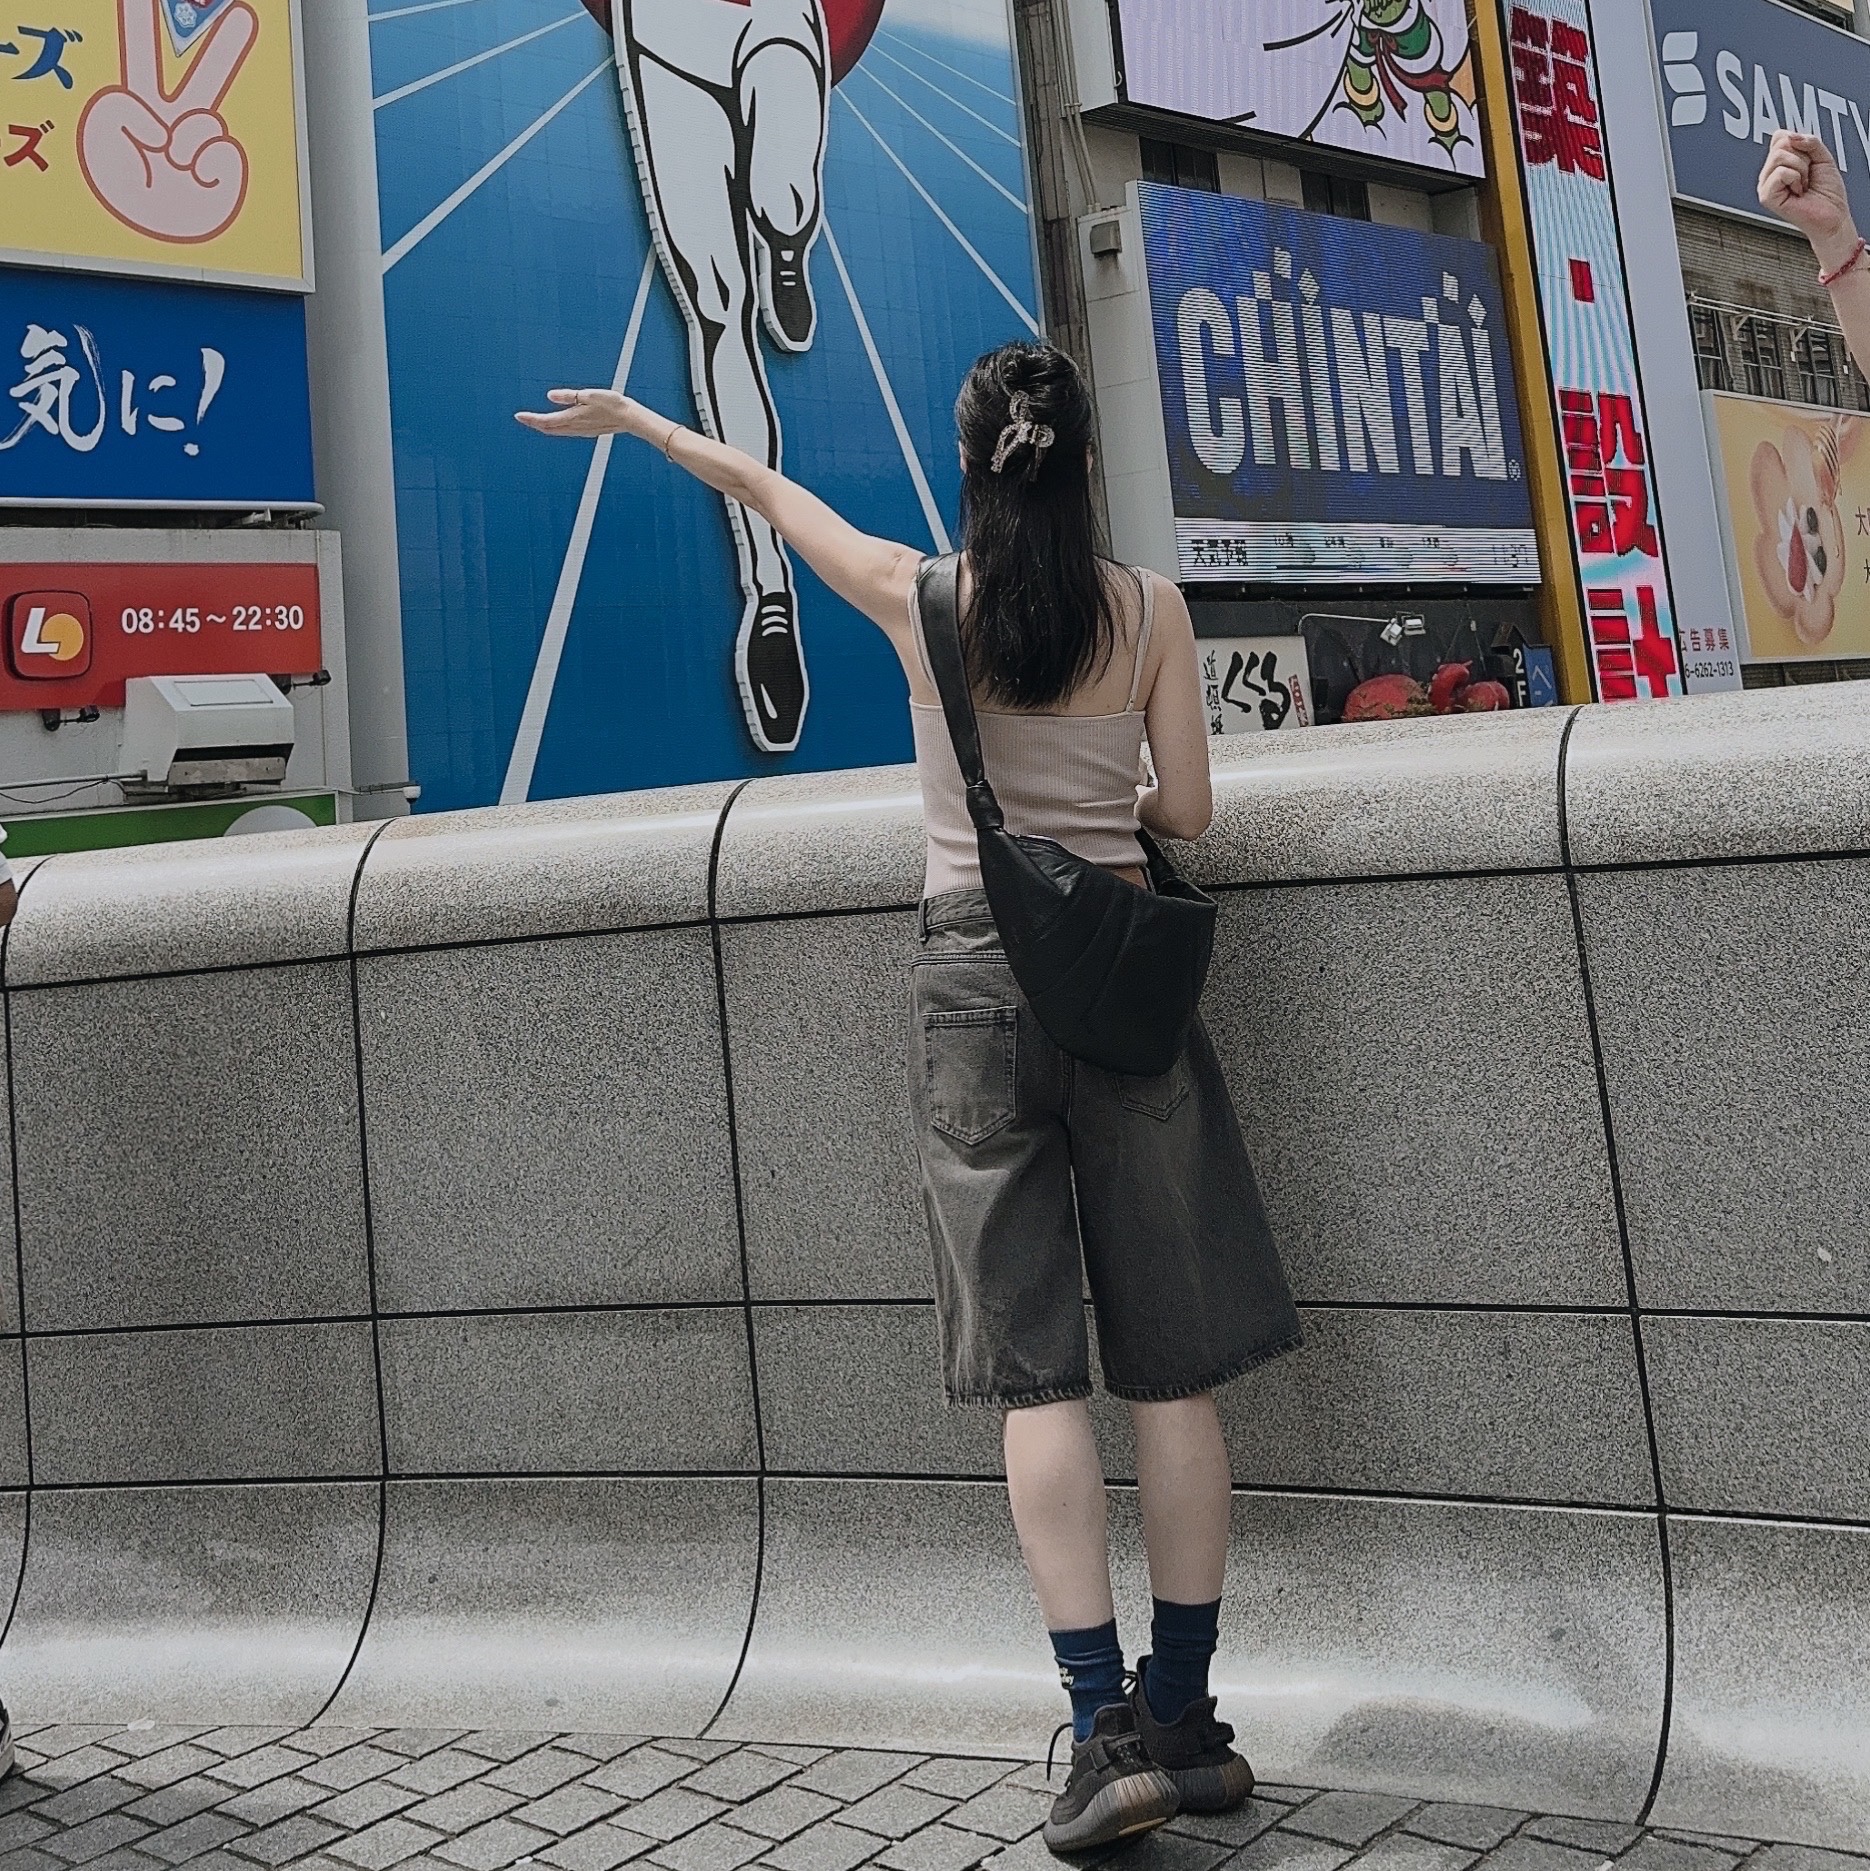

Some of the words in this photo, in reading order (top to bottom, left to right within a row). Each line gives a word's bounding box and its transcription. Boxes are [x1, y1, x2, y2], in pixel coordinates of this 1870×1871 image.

[1178, 262, 1508, 481] CHINTAI
[1221, 651, 1291, 730] くくる
